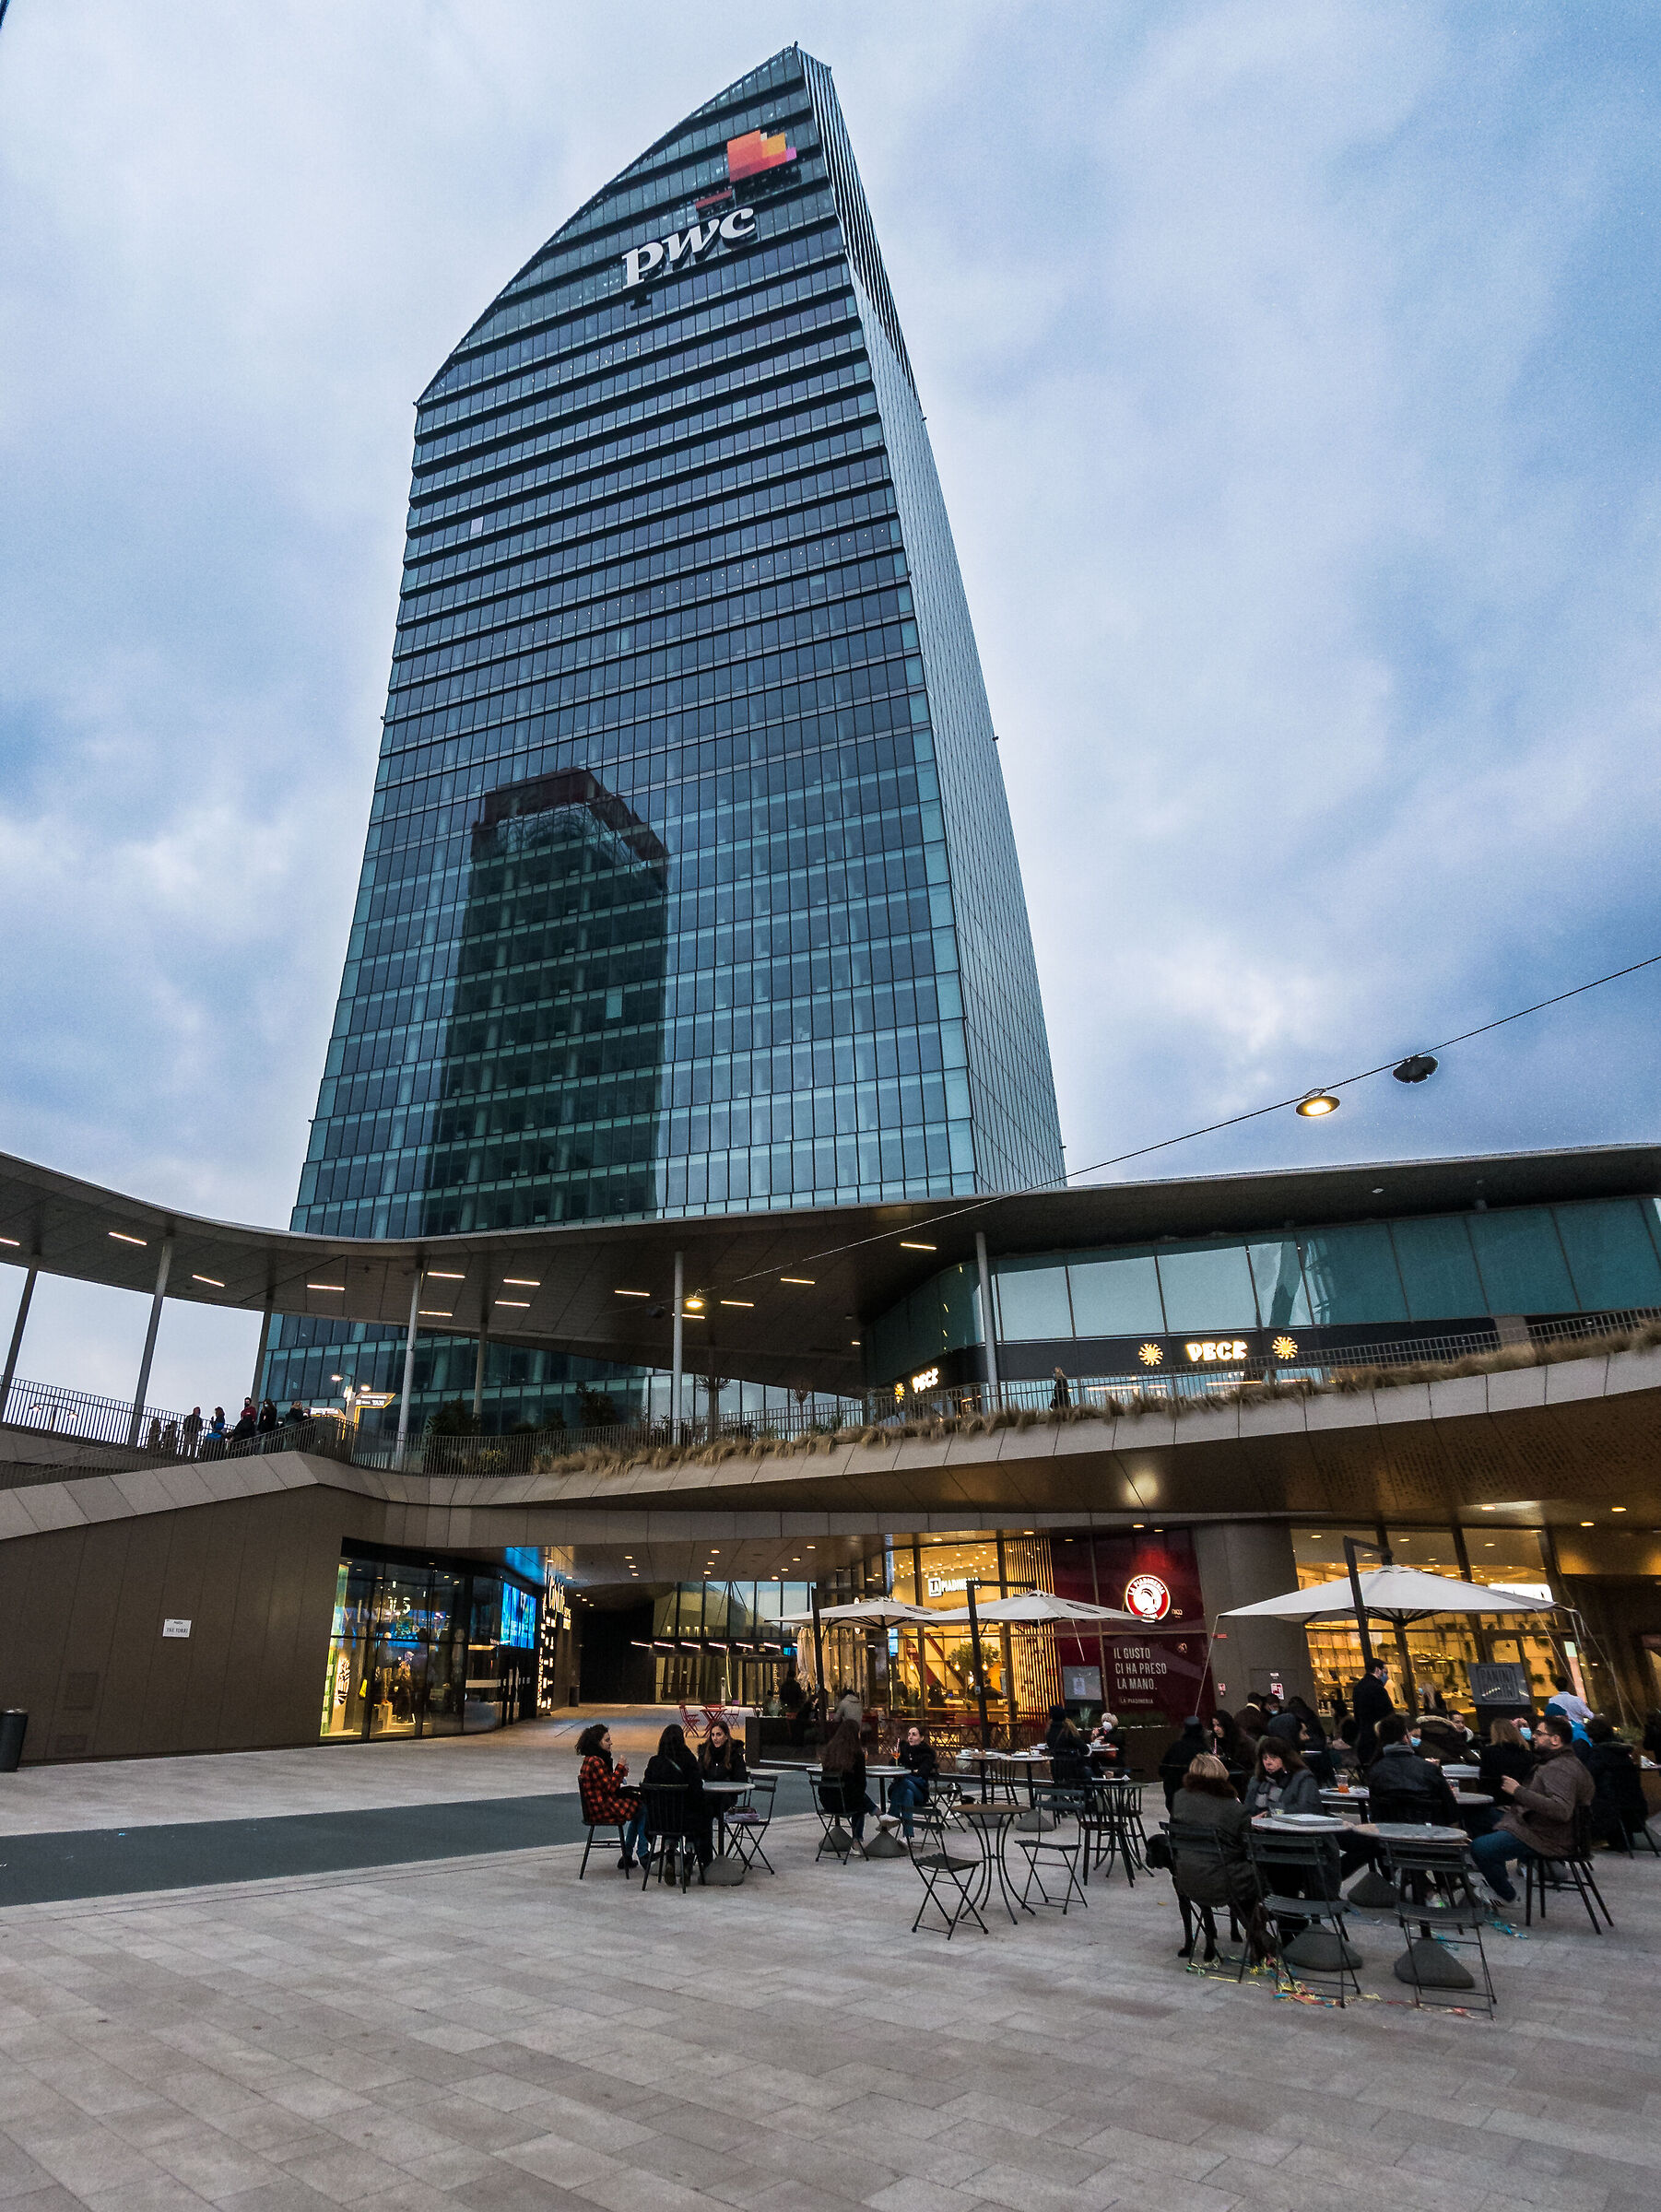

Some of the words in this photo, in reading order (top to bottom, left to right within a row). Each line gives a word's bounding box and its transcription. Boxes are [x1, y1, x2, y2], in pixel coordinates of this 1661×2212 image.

[621, 207, 756, 289] pwc
[1185, 1341, 1248, 1362] PECK
[1113, 1648, 1121, 1659] IL
[1124, 1647, 1150, 1659] GUSTO
[1115, 1663, 1123, 1674] CI
[1126, 1663, 1137, 1674] HA
[1139, 1663, 1167, 1674] PRESO
[1117, 1678, 1127, 1689] LA
[1129, 1678, 1158, 1689] MANO.
